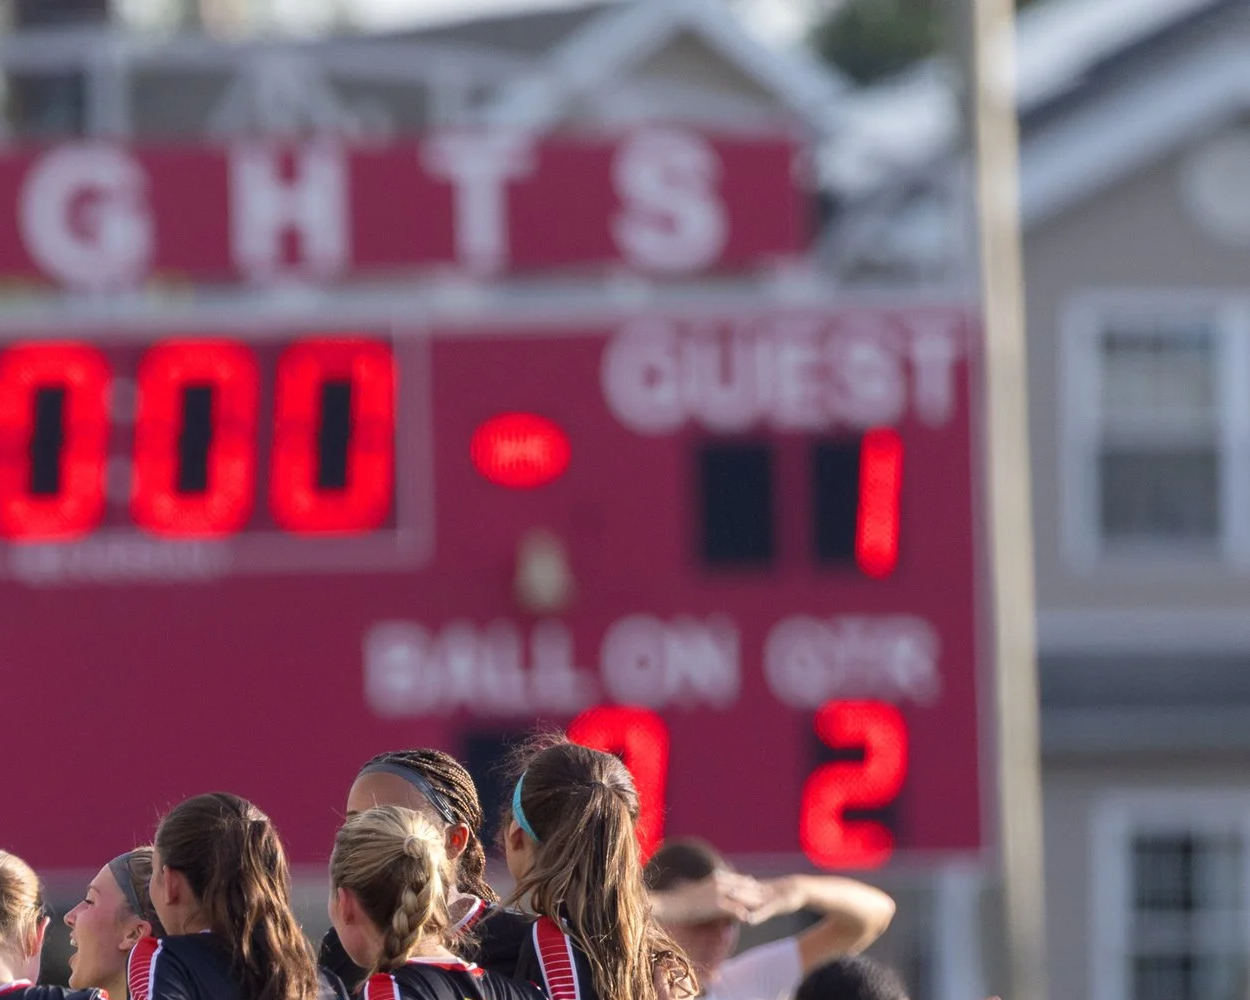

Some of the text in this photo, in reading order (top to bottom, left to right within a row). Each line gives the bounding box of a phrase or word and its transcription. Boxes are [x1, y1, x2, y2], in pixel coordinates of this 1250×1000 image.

[602, 316, 963, 431] GUEST
[855, 427, 904, 579] 1
[363, 614, 742, 716] BALL ON
[764, 614, 942, 703] QTR
[799, 699, 908, 870] 2
